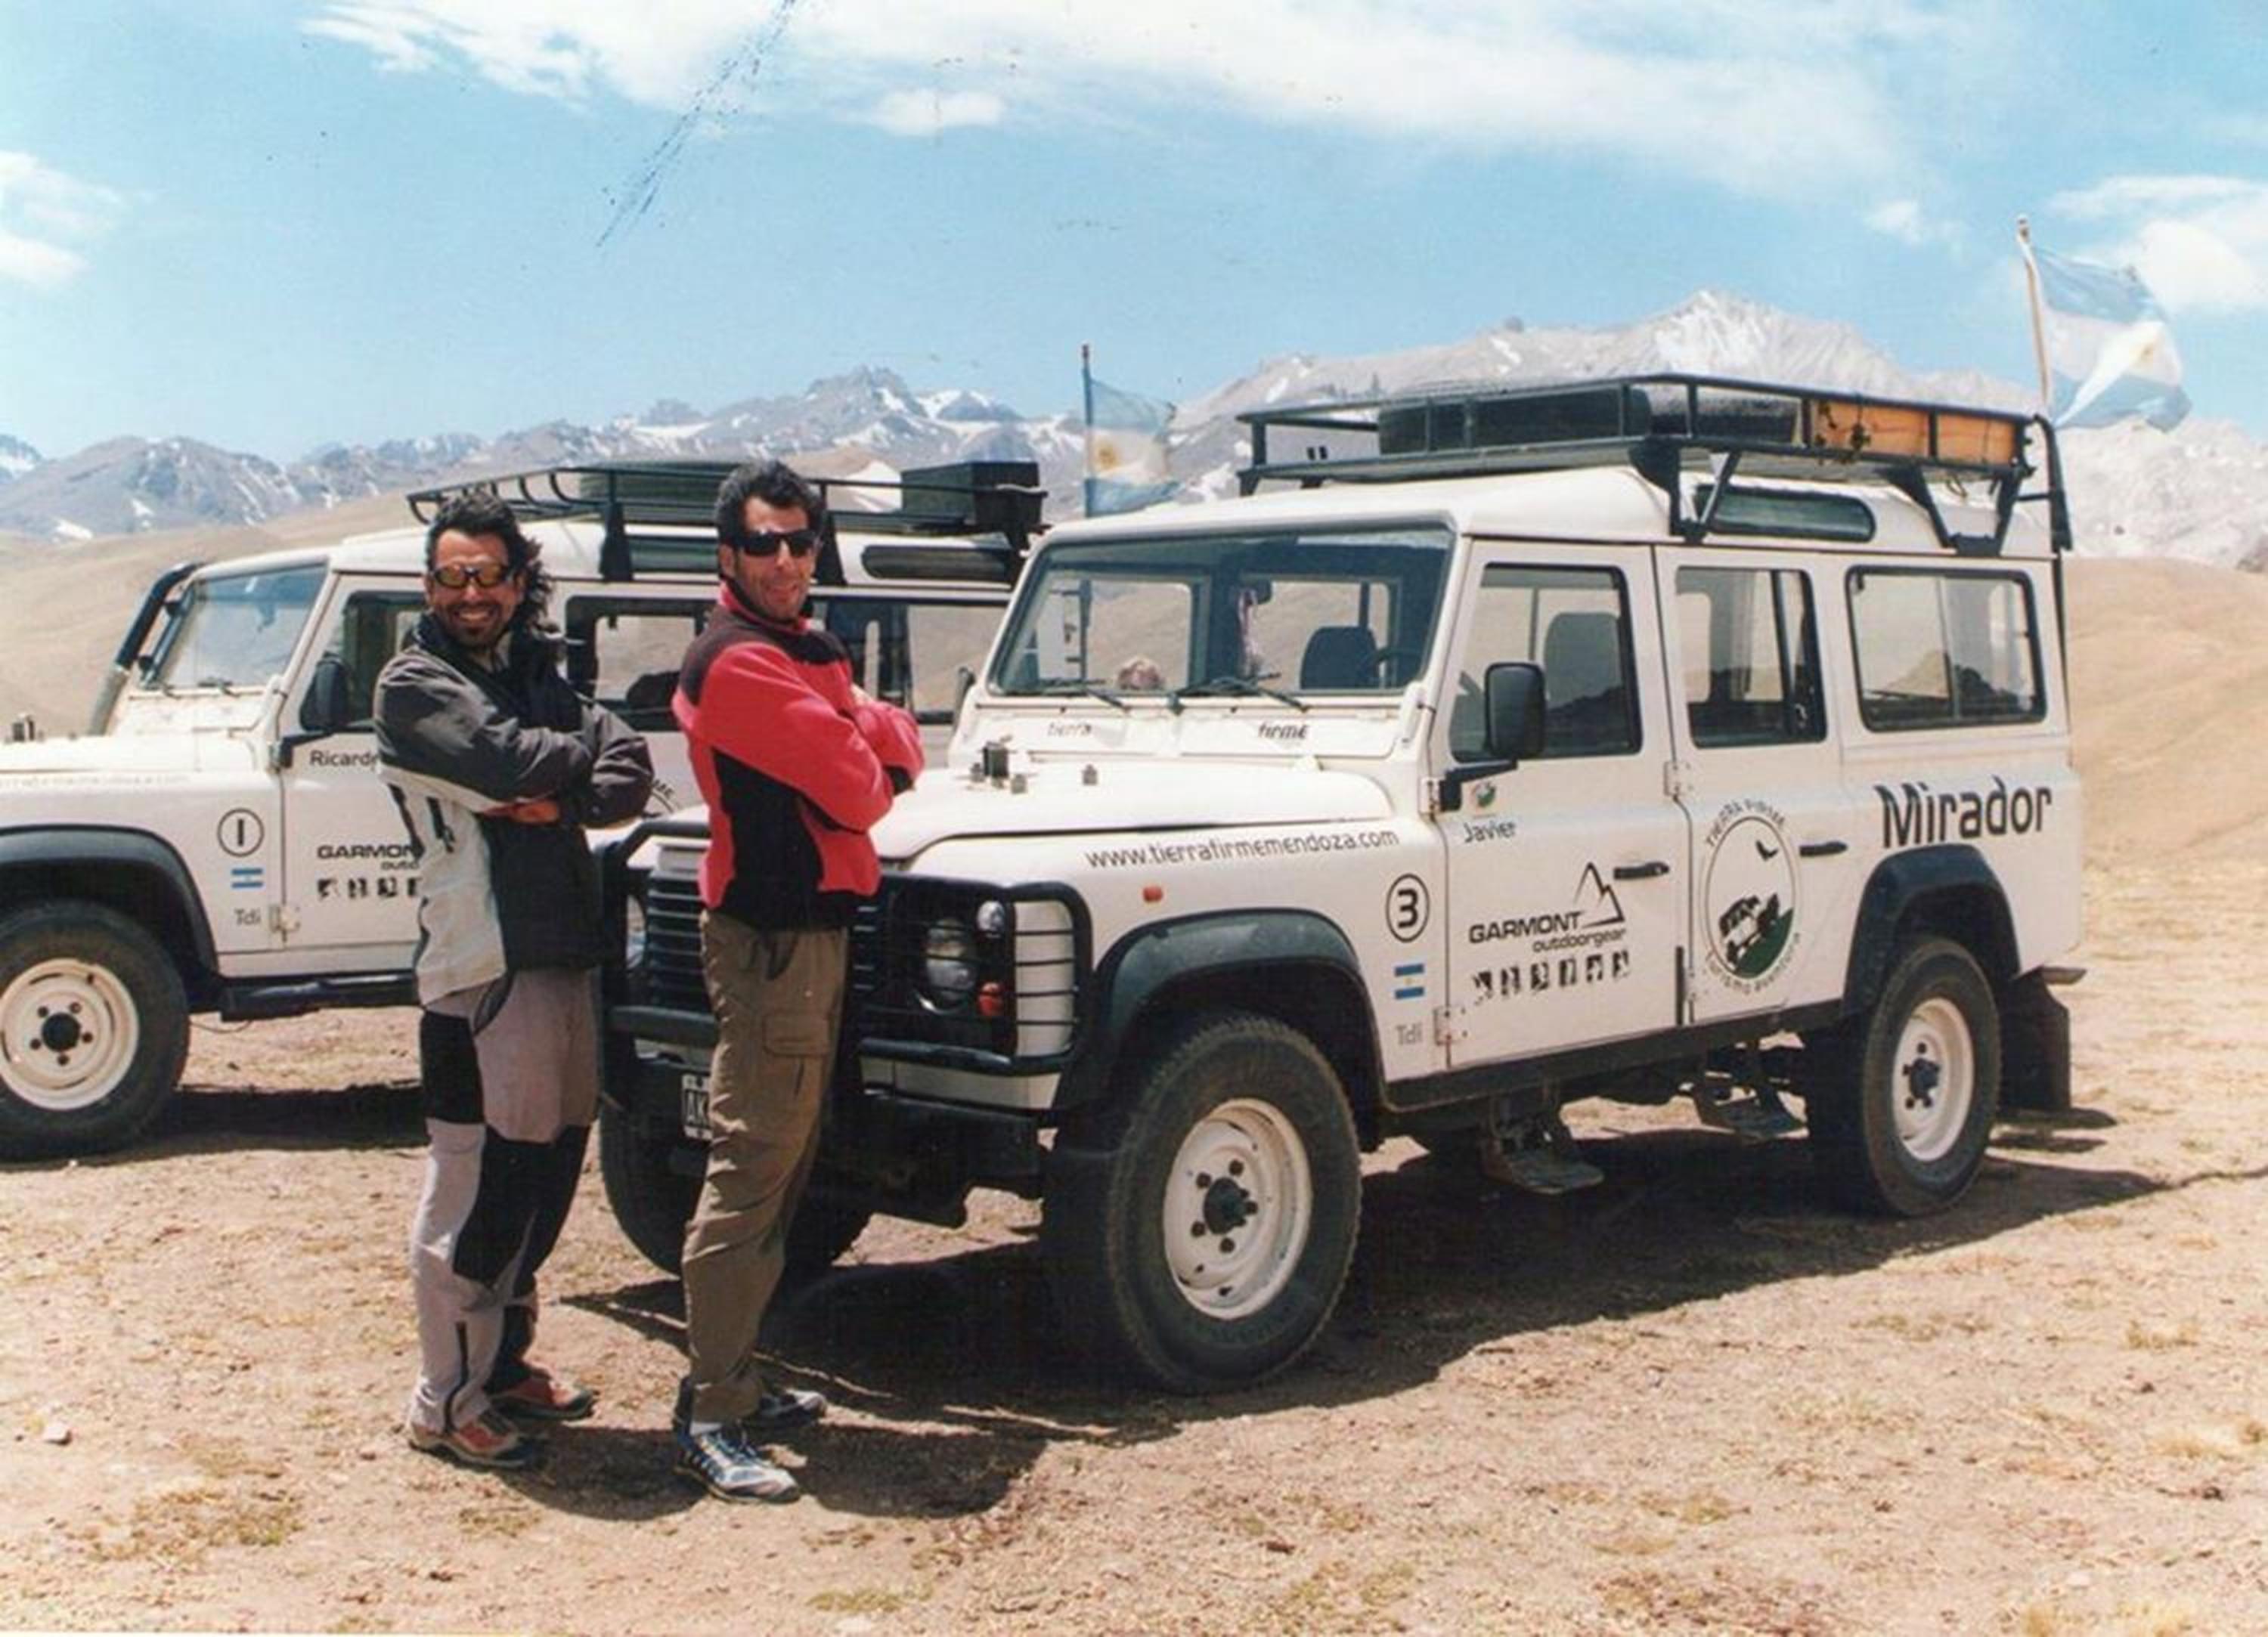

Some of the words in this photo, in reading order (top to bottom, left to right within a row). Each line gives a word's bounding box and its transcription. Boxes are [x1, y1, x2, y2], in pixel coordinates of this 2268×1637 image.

[1873, 774, 2052, 849] Mirador
[1464, 820, 1517, 843] Javier
[317, 844, 415, 860] GARMON
[1085, 829, 1399, 869] www.tierrafirmemendoza.com
[1397, 888, 1418, 929] 3
[1469, 910, 1583, 944] GARMONT
[1532, 929, 1626, 952] outdoorgear
